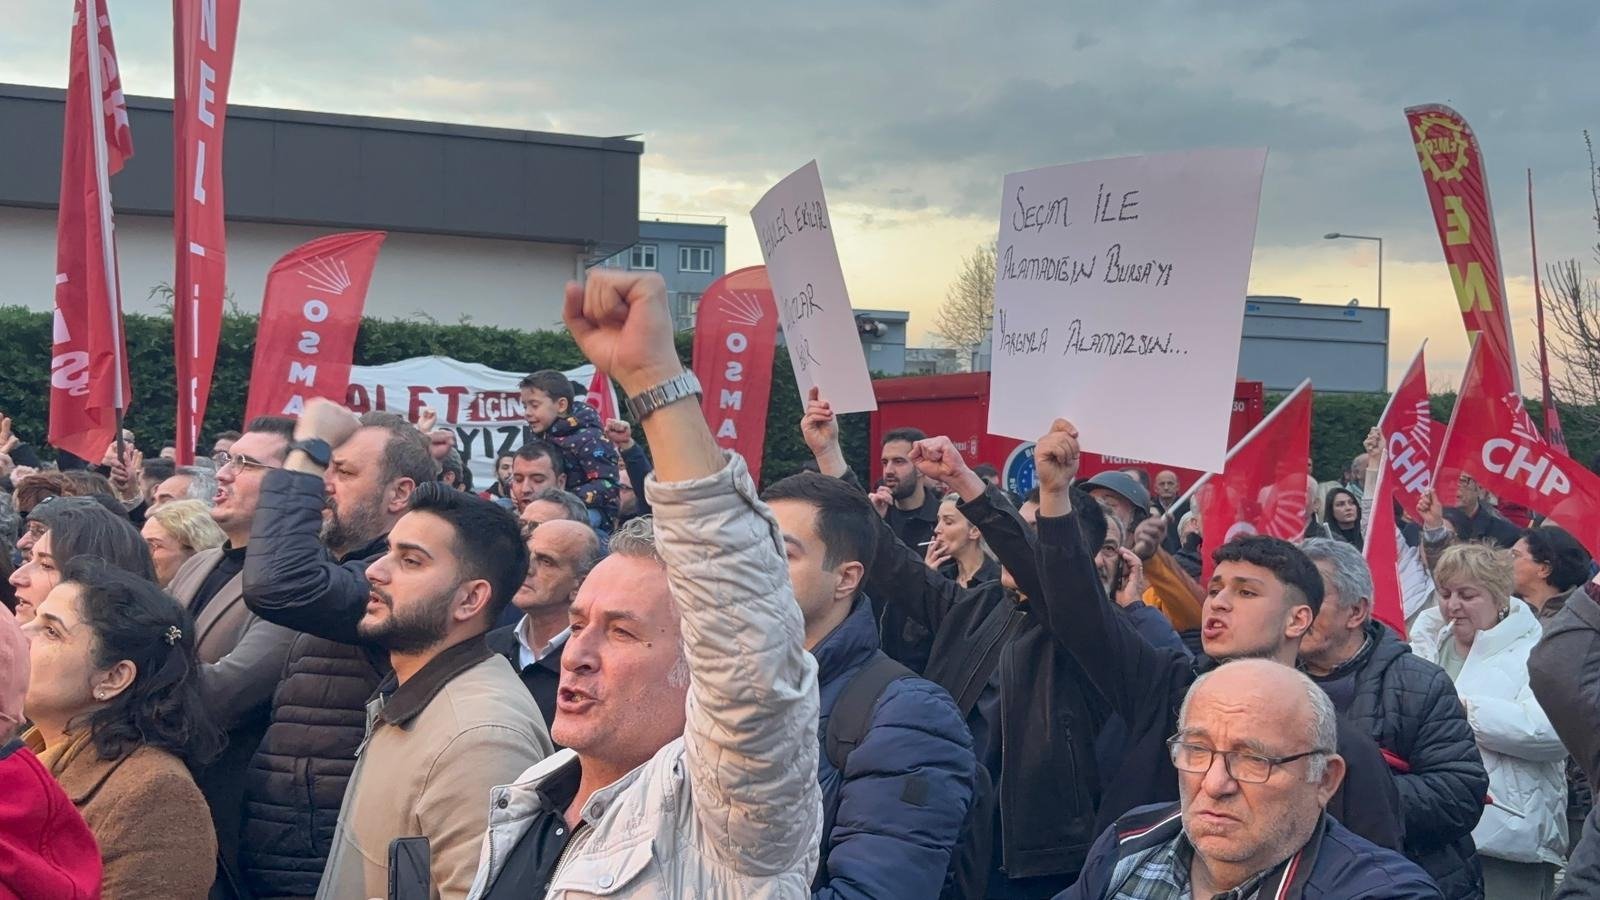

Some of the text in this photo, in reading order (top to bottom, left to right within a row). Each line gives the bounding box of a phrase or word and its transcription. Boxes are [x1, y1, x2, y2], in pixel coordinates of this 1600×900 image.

[1012, 183, 1139, 233] SEÇİM İLE
[1001, 244, 1097, 286] ALAMADIĞIN
[1388, 432, 1431, 493] CHP
[1481, 438, 1571, 496] CHP
